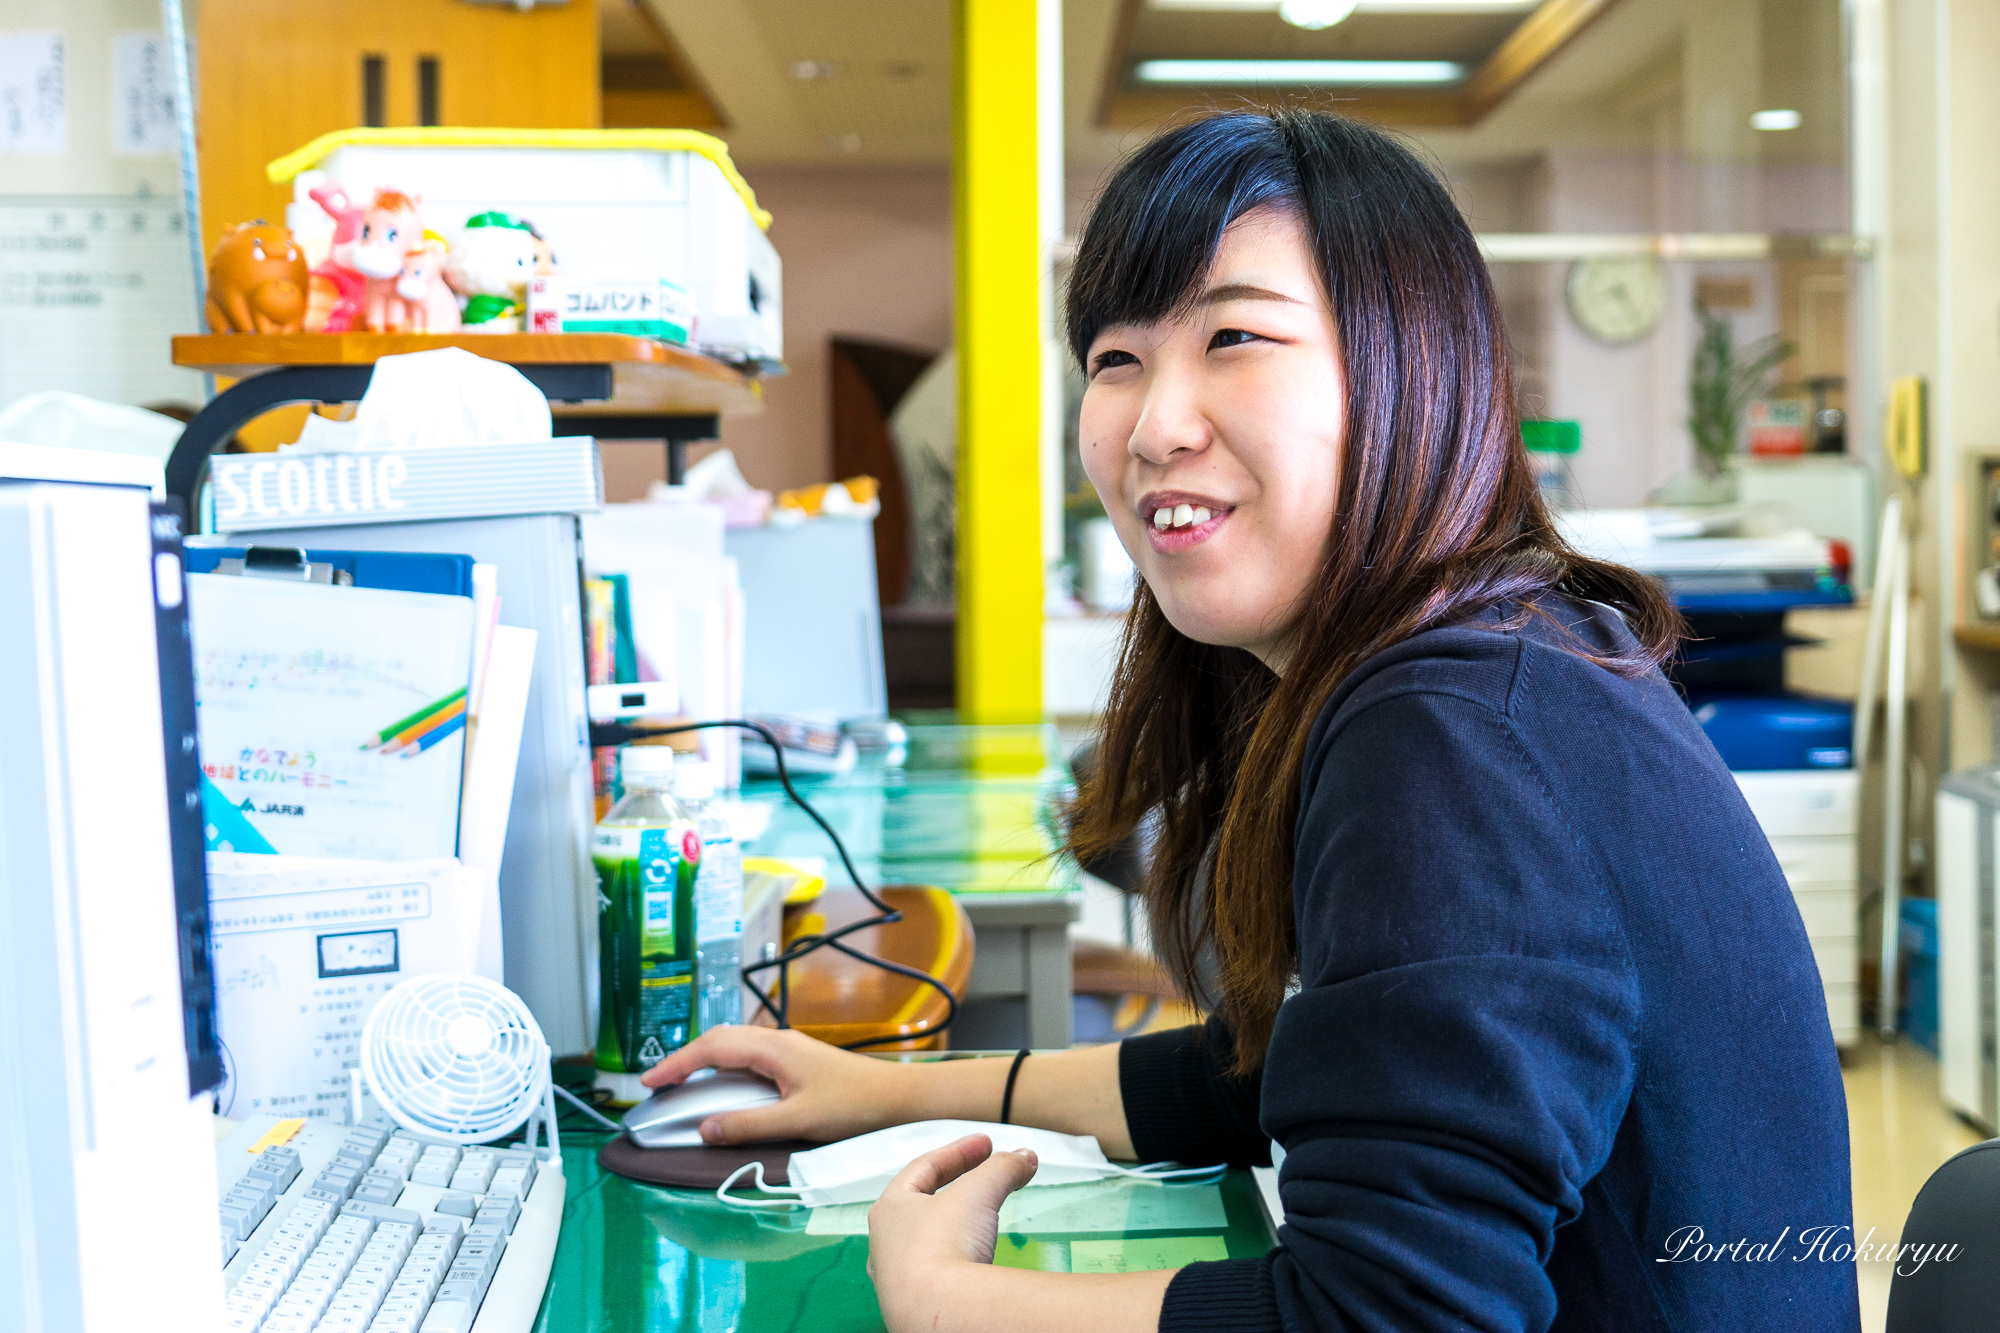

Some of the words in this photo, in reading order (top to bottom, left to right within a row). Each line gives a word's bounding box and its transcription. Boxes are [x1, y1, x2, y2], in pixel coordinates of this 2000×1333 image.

[566, 291, 653, 312] ゴムバンド
[219, 454, 407, 519] scottie
[239, 747, 316, 768] かなでよう
[203, 763, 348, 788] 地域とのハーモニー
